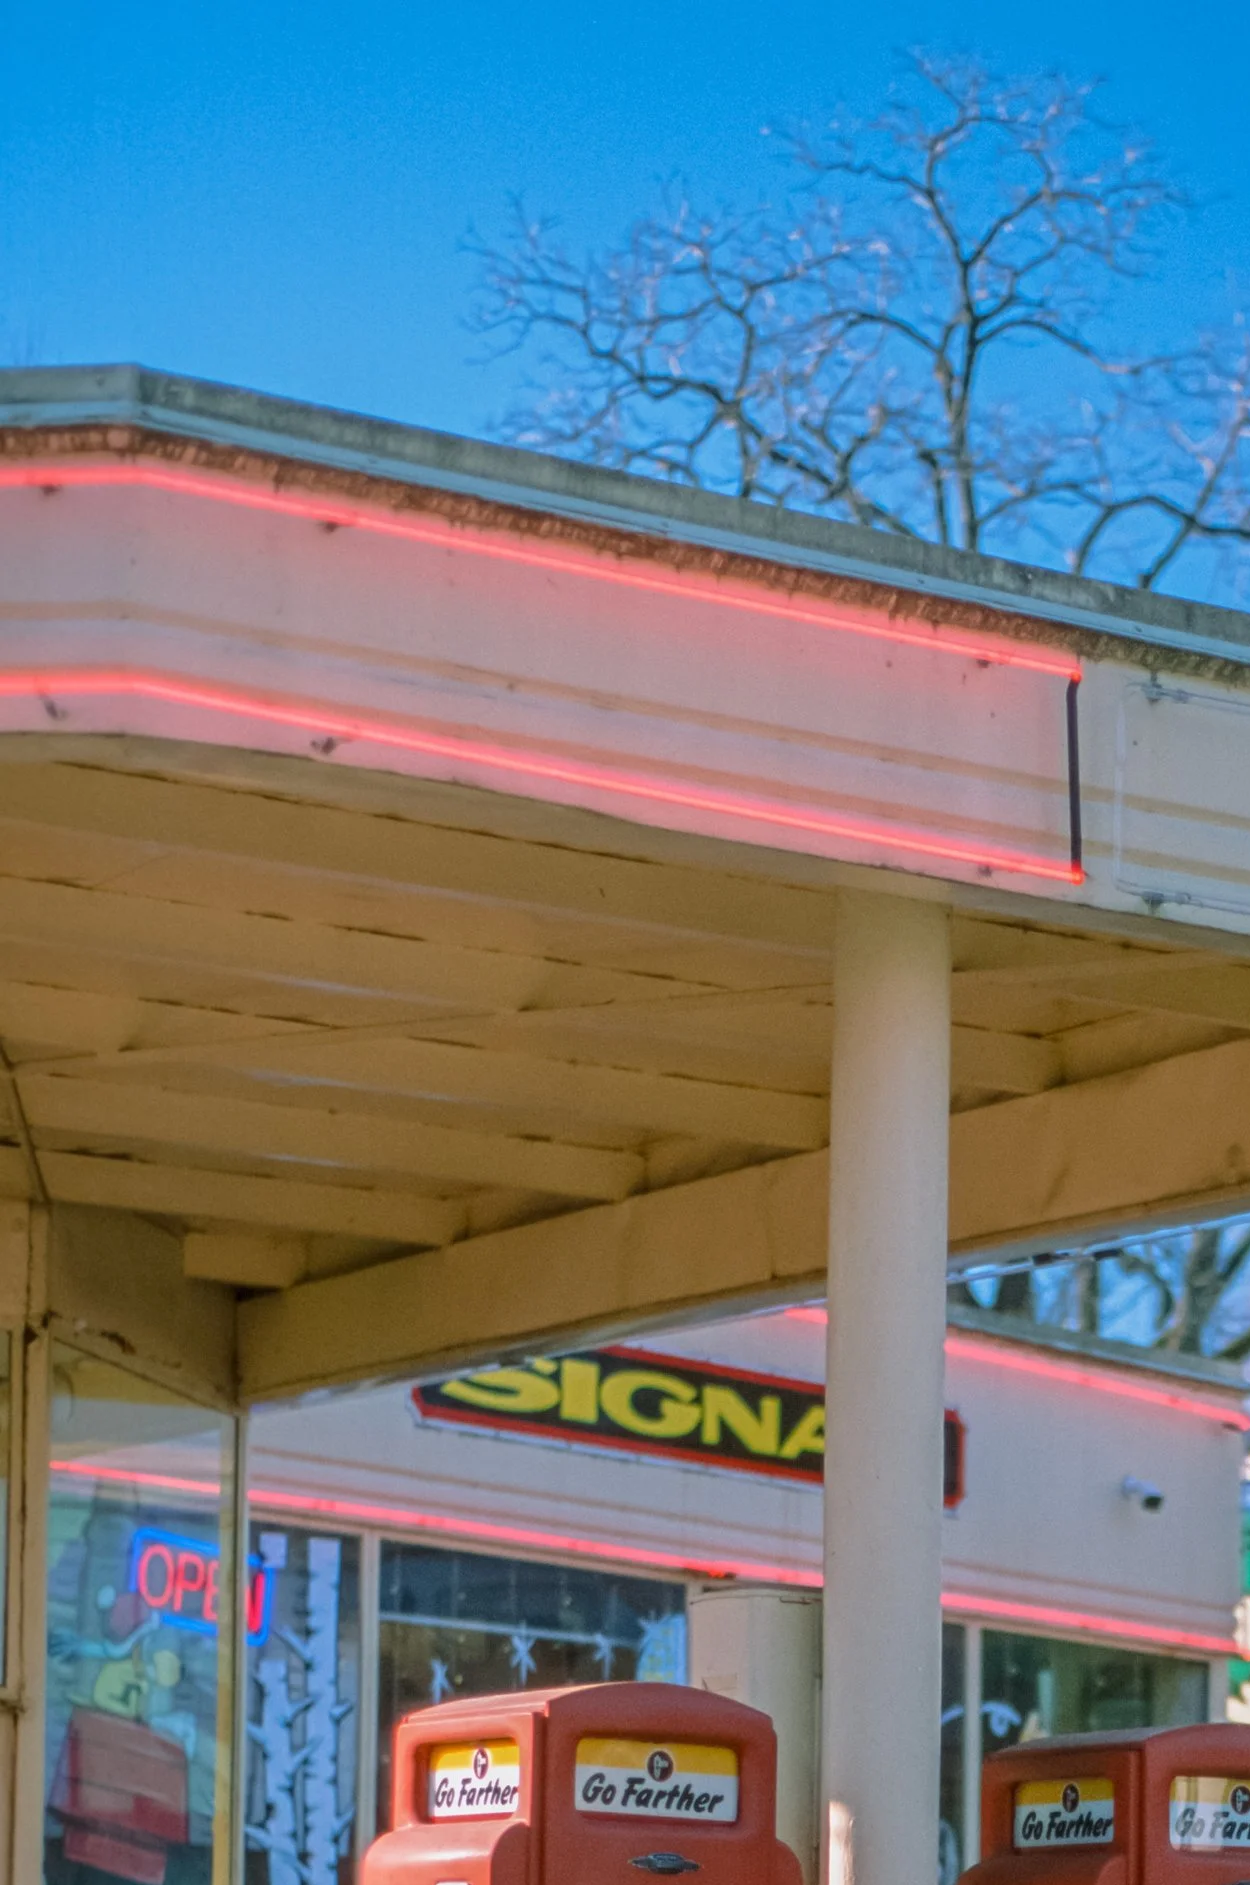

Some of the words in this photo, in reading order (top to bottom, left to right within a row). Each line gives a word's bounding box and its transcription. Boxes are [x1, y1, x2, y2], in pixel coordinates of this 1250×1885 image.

[440, 1356, 825, 1459] SIGNA
[434, 1777, 454, 1807] Go
[458, 1777, 518, 1807] Farther
[581, 1772, 617, 1805] Go
[621, 1776, 724, 1813] Farther
[1022, 1811, 1043, 1840] Go
[1046, 1811, 1113, 1841] Farther
[1175, 1808, 1206, 1838] Go
